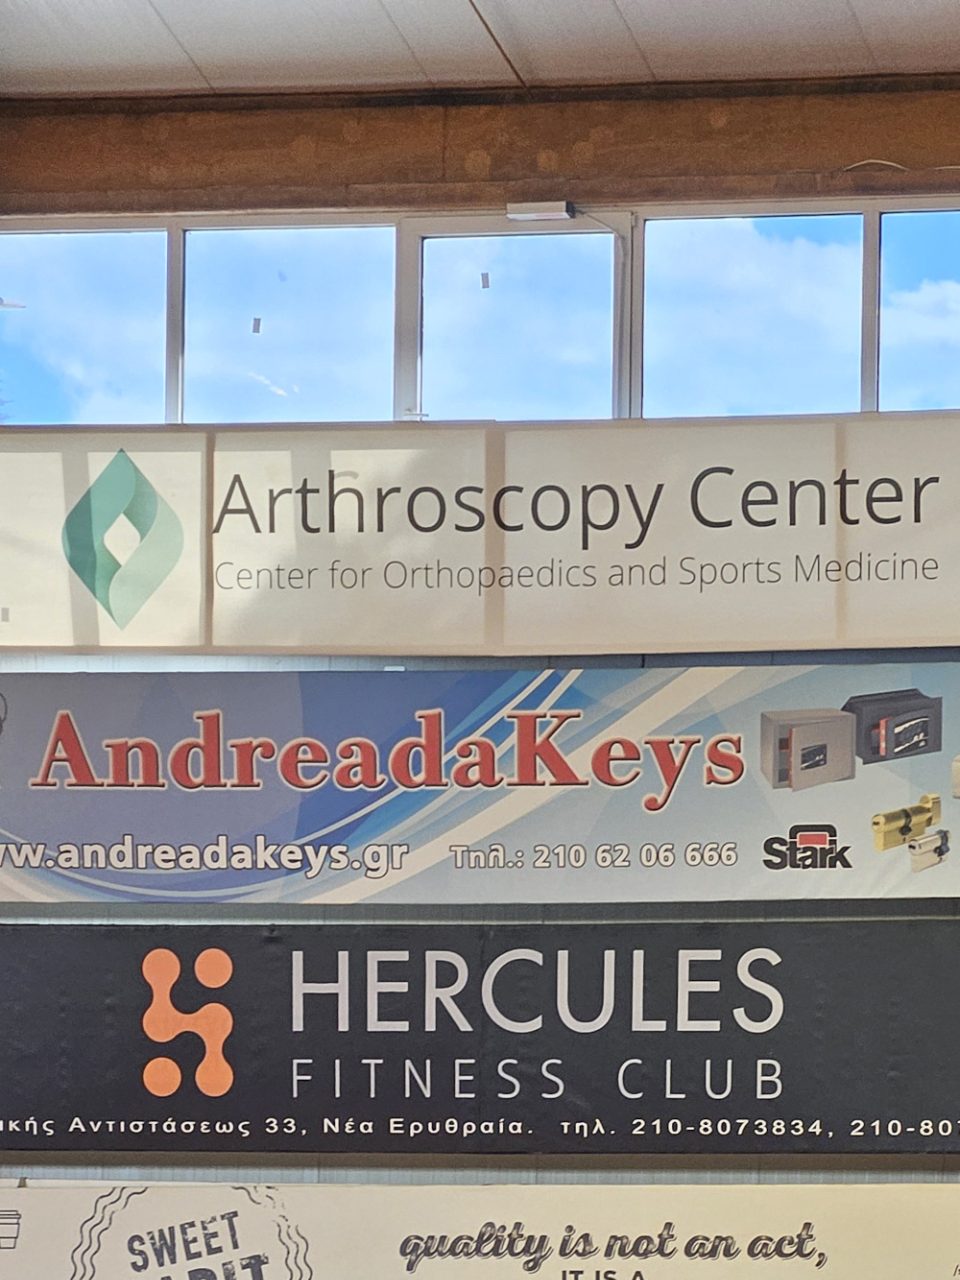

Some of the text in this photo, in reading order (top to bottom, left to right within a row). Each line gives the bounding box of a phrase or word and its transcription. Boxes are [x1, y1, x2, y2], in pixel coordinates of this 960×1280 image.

[212, 466, 940, 550] Arthroscopy Center
[214, 551, 940, 596] Center for Orthopaedics and Sports Medicine
[30, 709, 746, 811] AndreadaKeys
[532, 843, 588, 868] 210
[595, 843, 631, 868] 62
[641, 843, 676, 868] 06
[684, 842, 738, 867] 666
[763, 836, 852, 870] Stark
[291, 947, 785, 1034] HERCULES
[291, 1058, 784, 1099] FITNESS CLUB
[68, 1116, 250, 1137] Αντιστάσεως
[264, 1117, 308, 1136] 33,
[323, 1115, 374, 1134] Νέα
[389, 1115, 534, 1137] Ερυθραία.
[631, 1117, 834, 1139] 210-8073834,
[127, 1210, 240, 1273] SWEET
[399, 1221, 828, 1273] quality is not an act,
